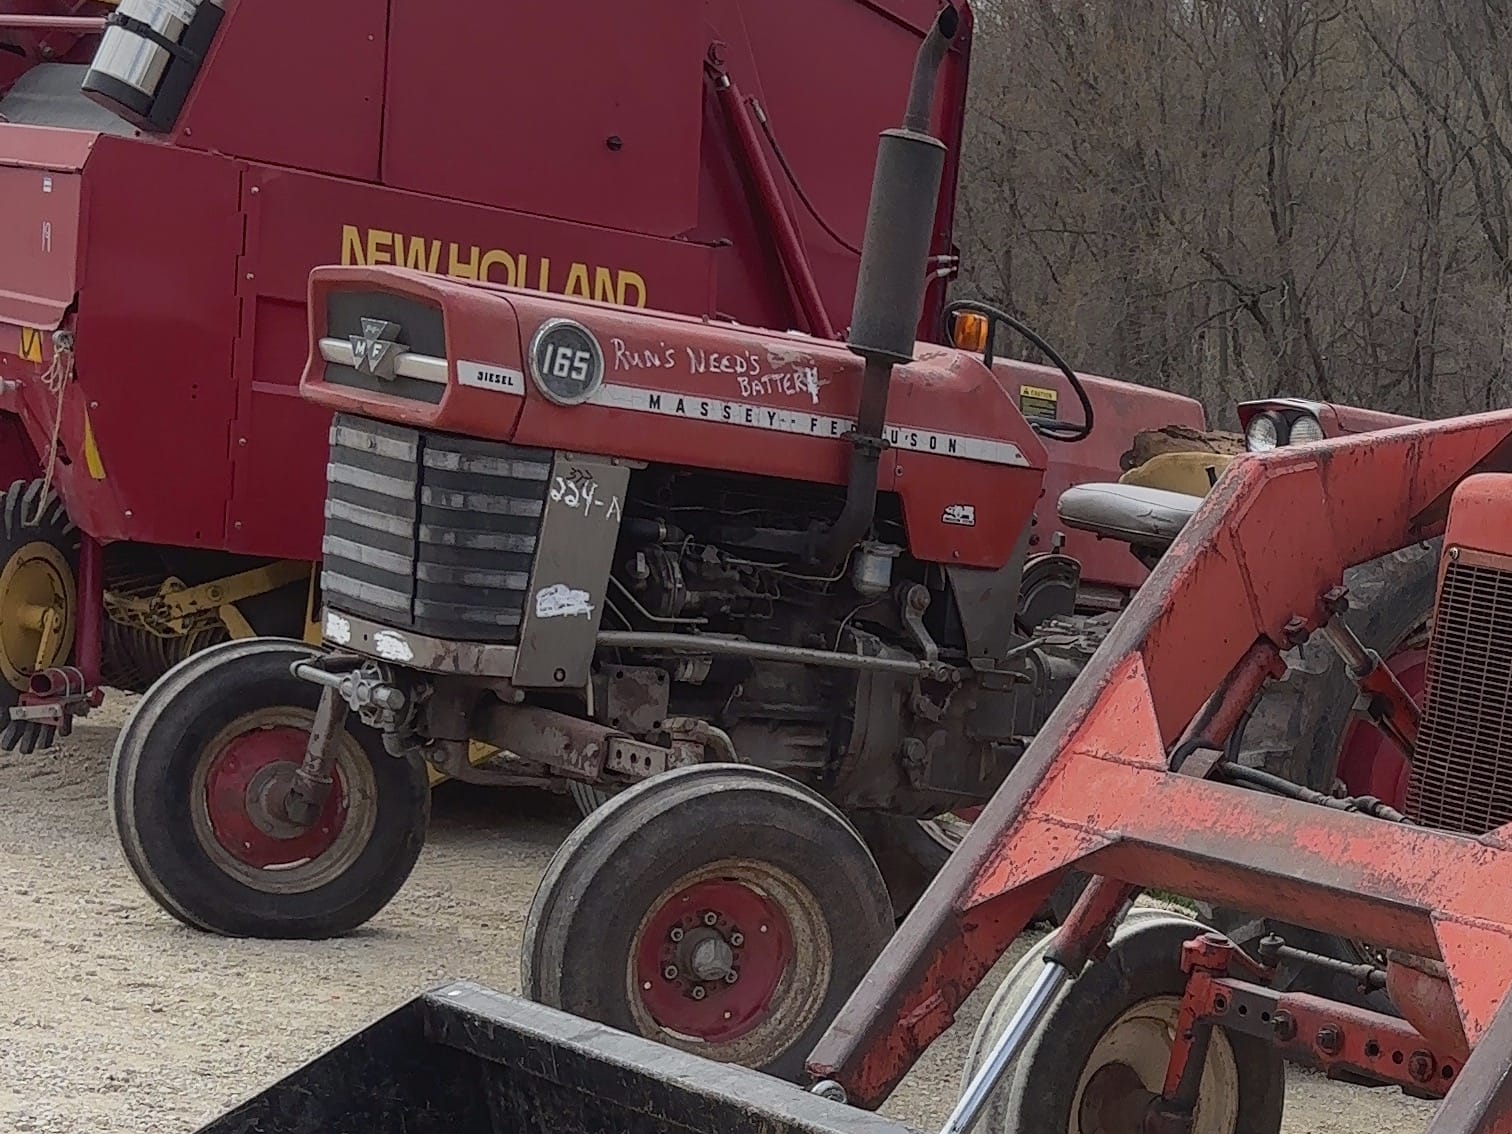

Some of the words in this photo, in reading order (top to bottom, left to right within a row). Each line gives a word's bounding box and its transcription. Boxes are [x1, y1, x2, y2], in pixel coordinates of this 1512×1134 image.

[340, 225, 442, 274] NEW
[448, 243, 648, 309] HOLLAND
[477, 371, 514, 386] DIESEL
[542, 343, 590, 381] 165
[648, 394, 957, 454] MASSEY-FEUSON
